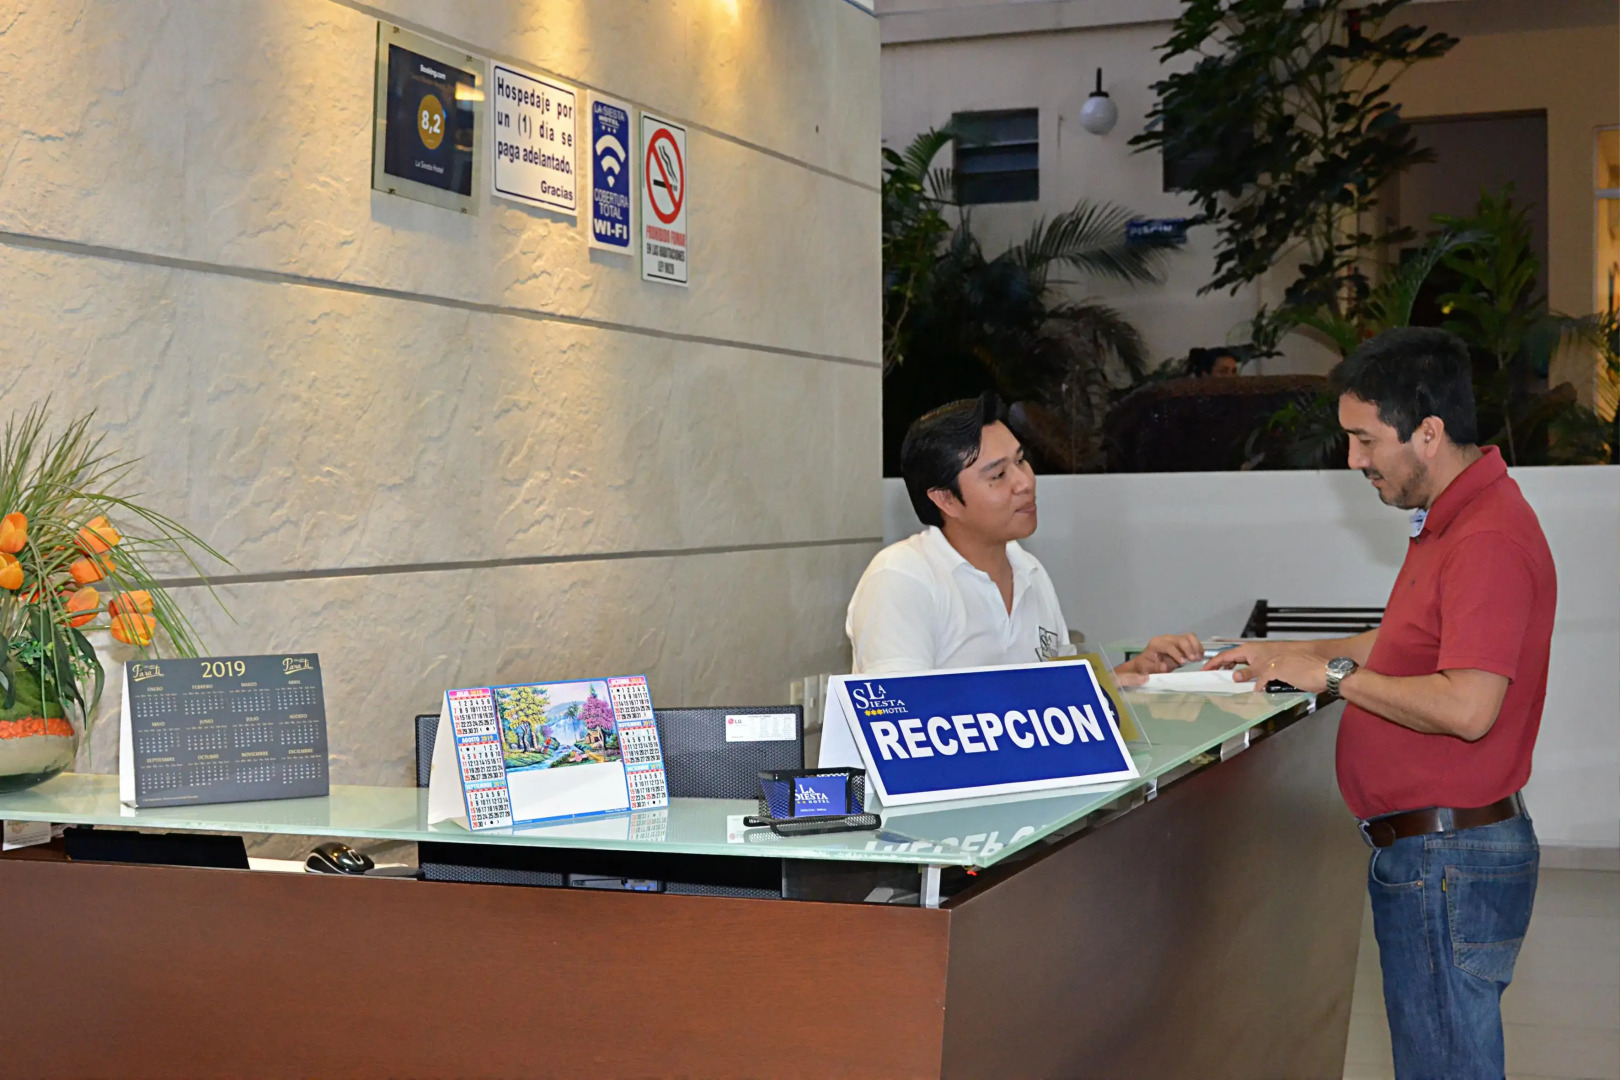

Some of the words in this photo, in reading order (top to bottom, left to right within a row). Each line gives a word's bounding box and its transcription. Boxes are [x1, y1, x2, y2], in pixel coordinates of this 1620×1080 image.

[498, 76, 550, 115] Hospedaje
[557, 102, 572, 120] por
[422, 110, 441, 134] 8,2
[594, 102, 602, 113] LA
[602, 105, 626, 122] SIESTA
[598, 115, 620, 126] HOTEL
[498, 110, 510, 128] un
[518, 113, 532, 139] (1)
[562, 132, 572, 147] se
[498, 140, 520, 163] paga
[522, 145, 572, 174] adelantado.
[540, 180, 573, 201] Gracias
[594, 188, 628, 208] COBERTURA
[599, 202, 623, 220] TOTAL
[594, 218, 628, 240] WI-FI
[201, 660, 246, 678] 2019
[853, 688, 906, 709] SIESTA
[864, 682, 886, 700] LA
[870, 704, 1105, 760] RECEPCION
[799, 784, 816, 794] LA
